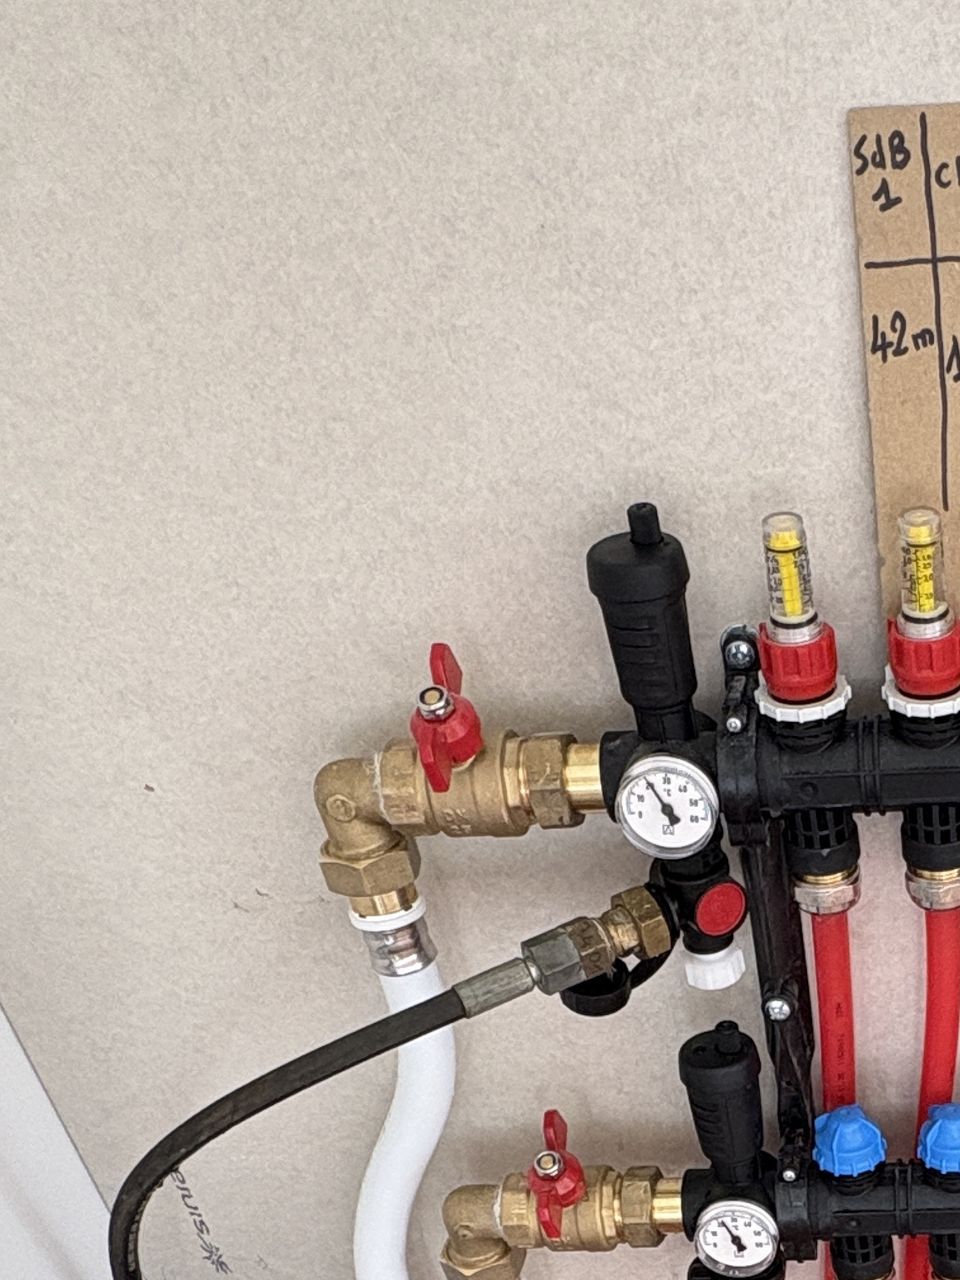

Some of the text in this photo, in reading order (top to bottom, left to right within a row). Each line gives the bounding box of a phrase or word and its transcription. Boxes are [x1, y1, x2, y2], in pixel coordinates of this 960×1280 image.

[854, 129, 912, 176] SdB
[871, 177, 903, 212] 1
[870, 310, 935, 364] 42m
[689, 799, 699, 807] 50
[170, 1166, 210, 1237] sinia
